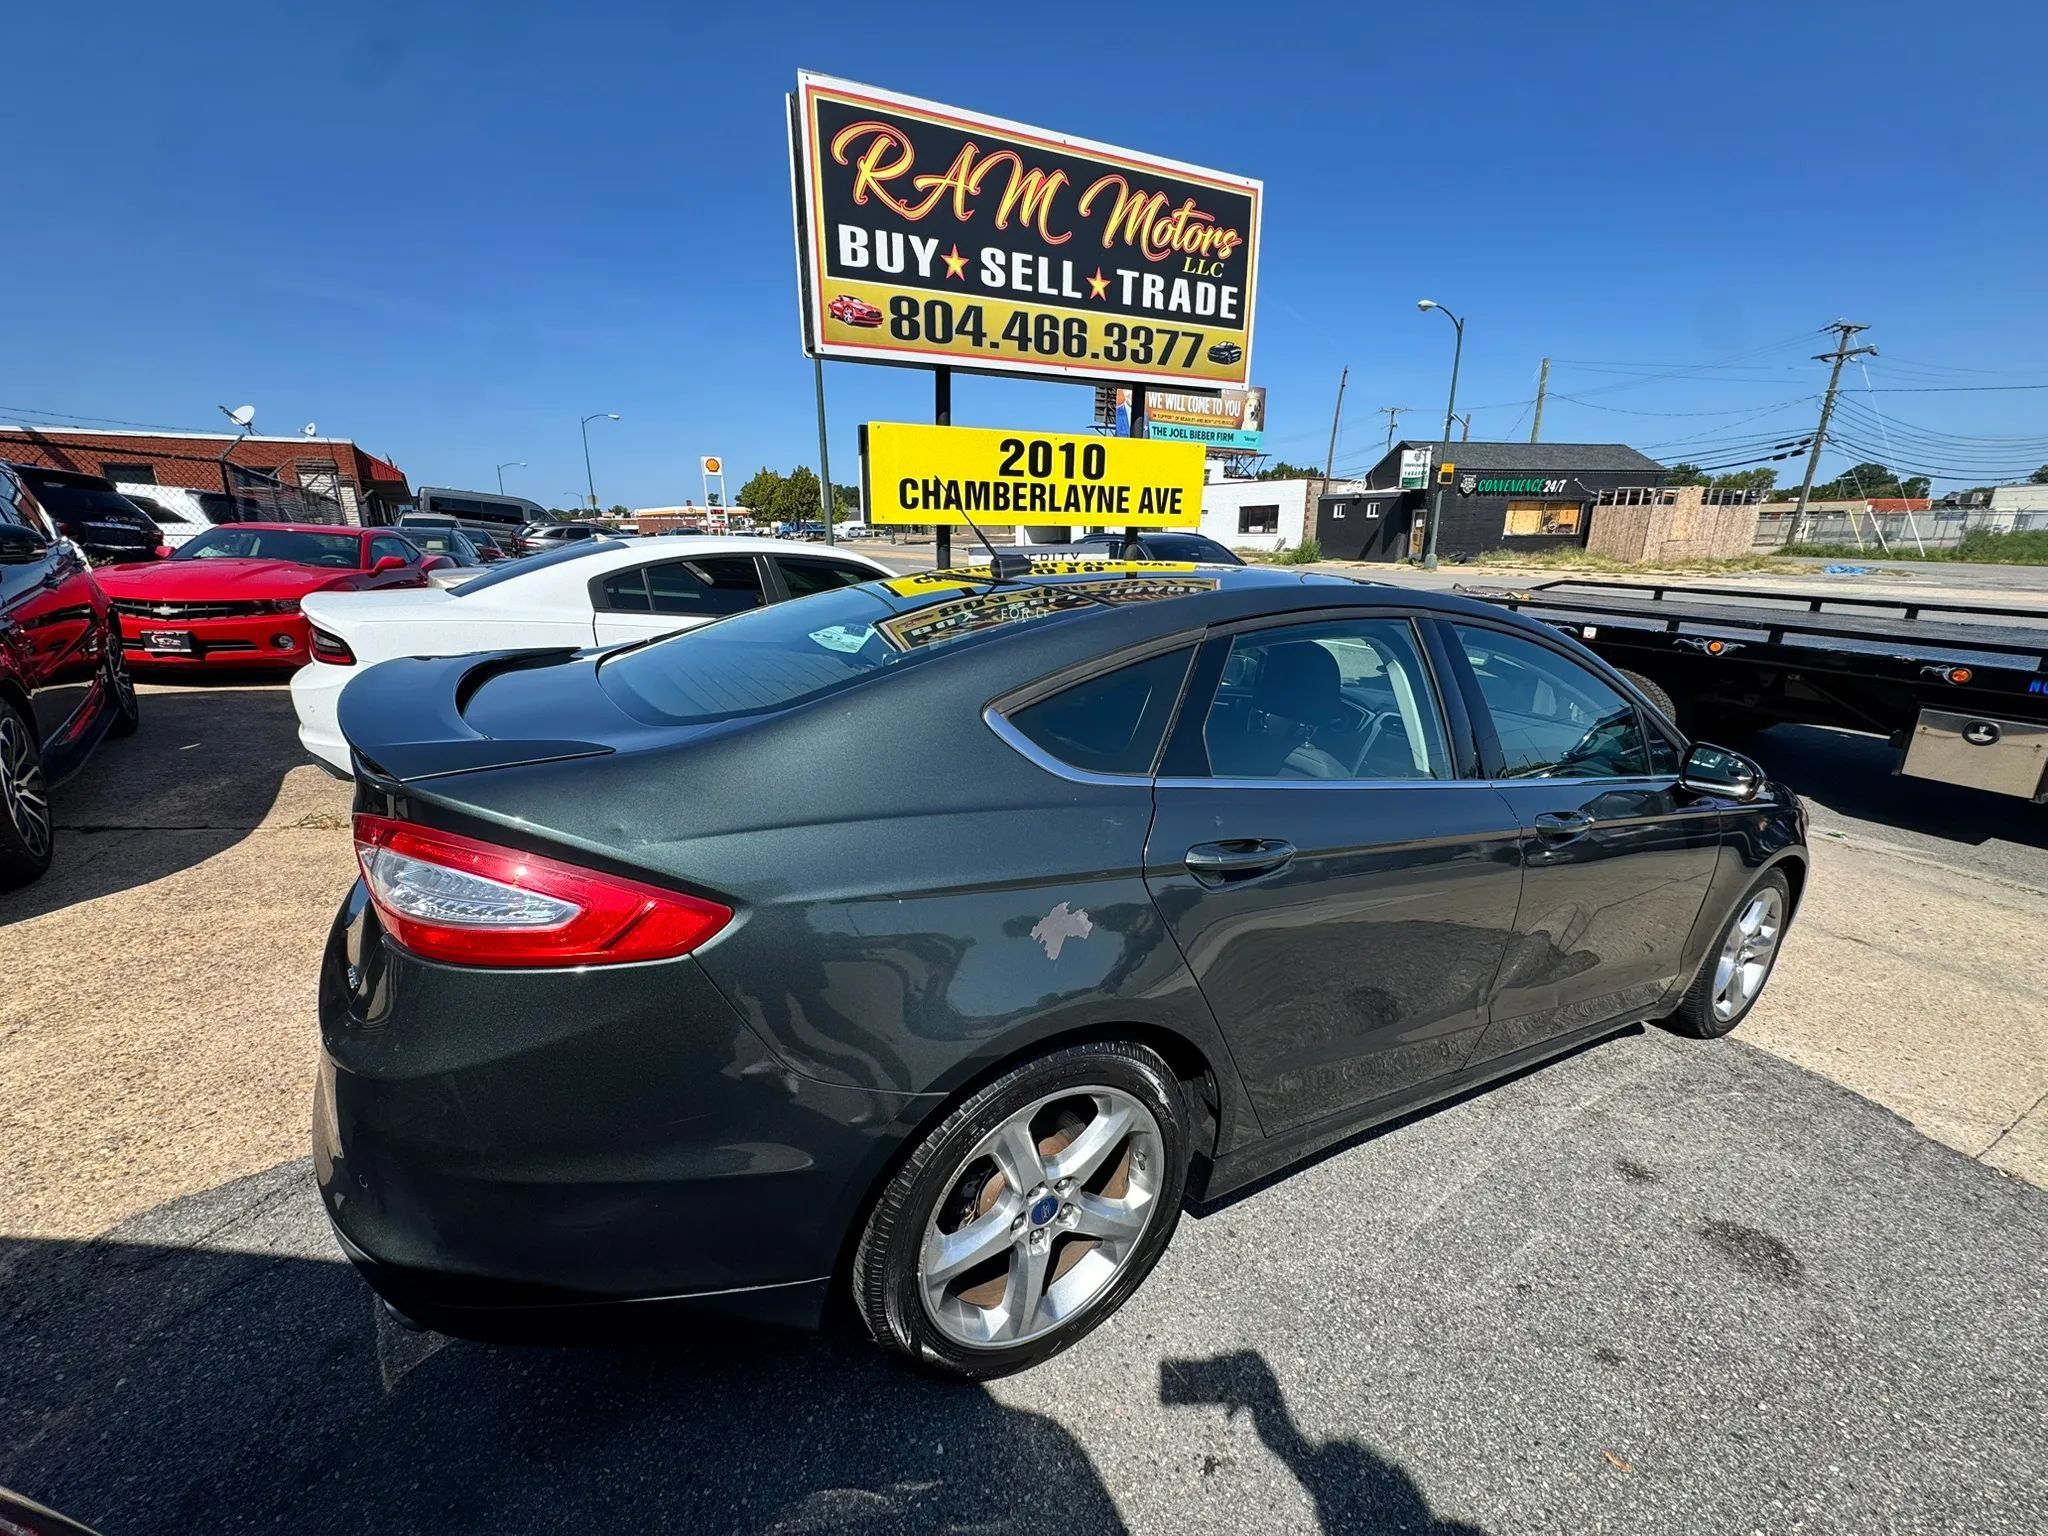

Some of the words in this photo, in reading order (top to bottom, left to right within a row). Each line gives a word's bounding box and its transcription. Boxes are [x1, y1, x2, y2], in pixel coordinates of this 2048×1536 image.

[831, 121, 1073, 245] RAM
[1077, 174, 1243, 262] Motors
[837, 224, 940, 278] BUY
[980, 247, 1083, 299] SELL
[1116, 268, 1239, 320] TRADE
[1182, 256, 1225, 278] LLC
[889, 295, 1205, 368] 804.466.3377
[1148, 391, 1164, 408] WE
[1165, 393, 1186, 412] WILL
[1187, 395, 1211, 415] COME
[1211, 398, 1223, 415] TO
[1224, 399, 1241, 417] YOU
[1151, 425, 1168, 436] THE
[1168, 427, 1189, 439] JOEL
[1189, 429, 1215, 441] BIEBER
[1216, 431, 1235, 442] FIRM
[998, 438, 1107, 481] 2010
[898, 477, 1131, 515] CHAMBERLAYNE
[1138, 486, 1183, 516] AVE
[1477, 478, 1545, 493] CONVENIENCE
[1543, 479, 1568, 493] 24/7
[1027, 551, 1081, 563] ERITY
